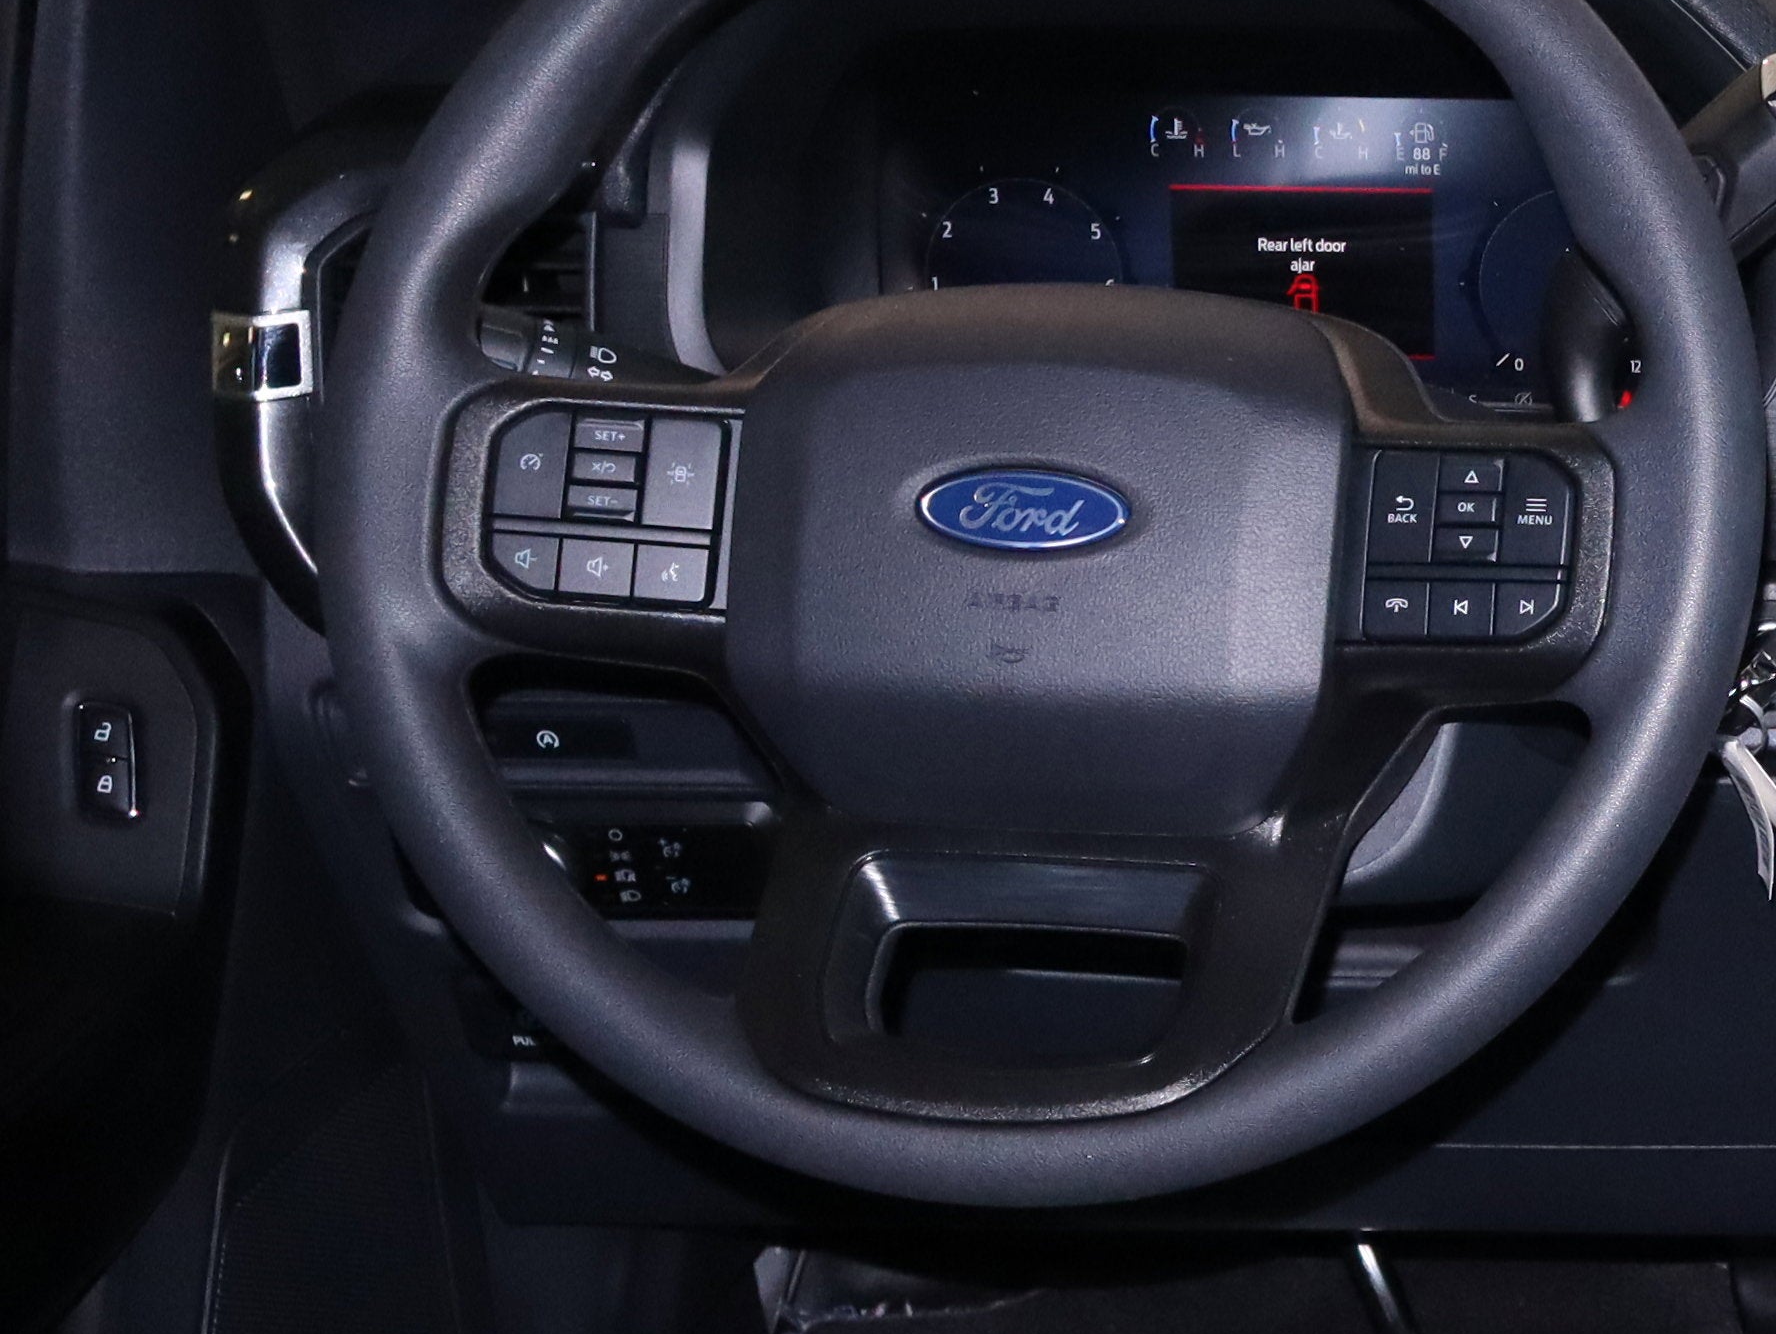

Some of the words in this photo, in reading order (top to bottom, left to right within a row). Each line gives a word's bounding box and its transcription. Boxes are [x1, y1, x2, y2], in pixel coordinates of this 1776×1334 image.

[1150, 144, 1159, 158] C
[1194, 145, 1204, 158] H
[1233, 144, 1241, 158] L
[1274, 145, 1285, 158] H
[1314, 146, 1323, 159] C
[1358, 147, 1368, 160] H
[1413, 147, 1430, 160] 88
[1405, 164, 1418, 175] mi
[1421, 164, 1432, 175] to
[1433, 164, 1441, 175] E
[988, 188, 999, 204] 3
[1043, 189, 1055, 205] 4
[942, 221, 952, 238] 2
[1090, 223, 1101, 240] 5
[1258, 238, 1288, 253] Rear
[1290, 238, 1314, 253] left
[1316, 238, 1346, 253] door
[1290, 259, 1315, 274] ajar
[1514, 358, 1524, 371] 0
[594, 430, 626, 442] SET+
[959, 482, 1086, 536] Ford
[1457, 502, 1475, 513] OK
[1388, 513, 1417, 524] BACK
[1517, 515, 1553, 526] MENU
